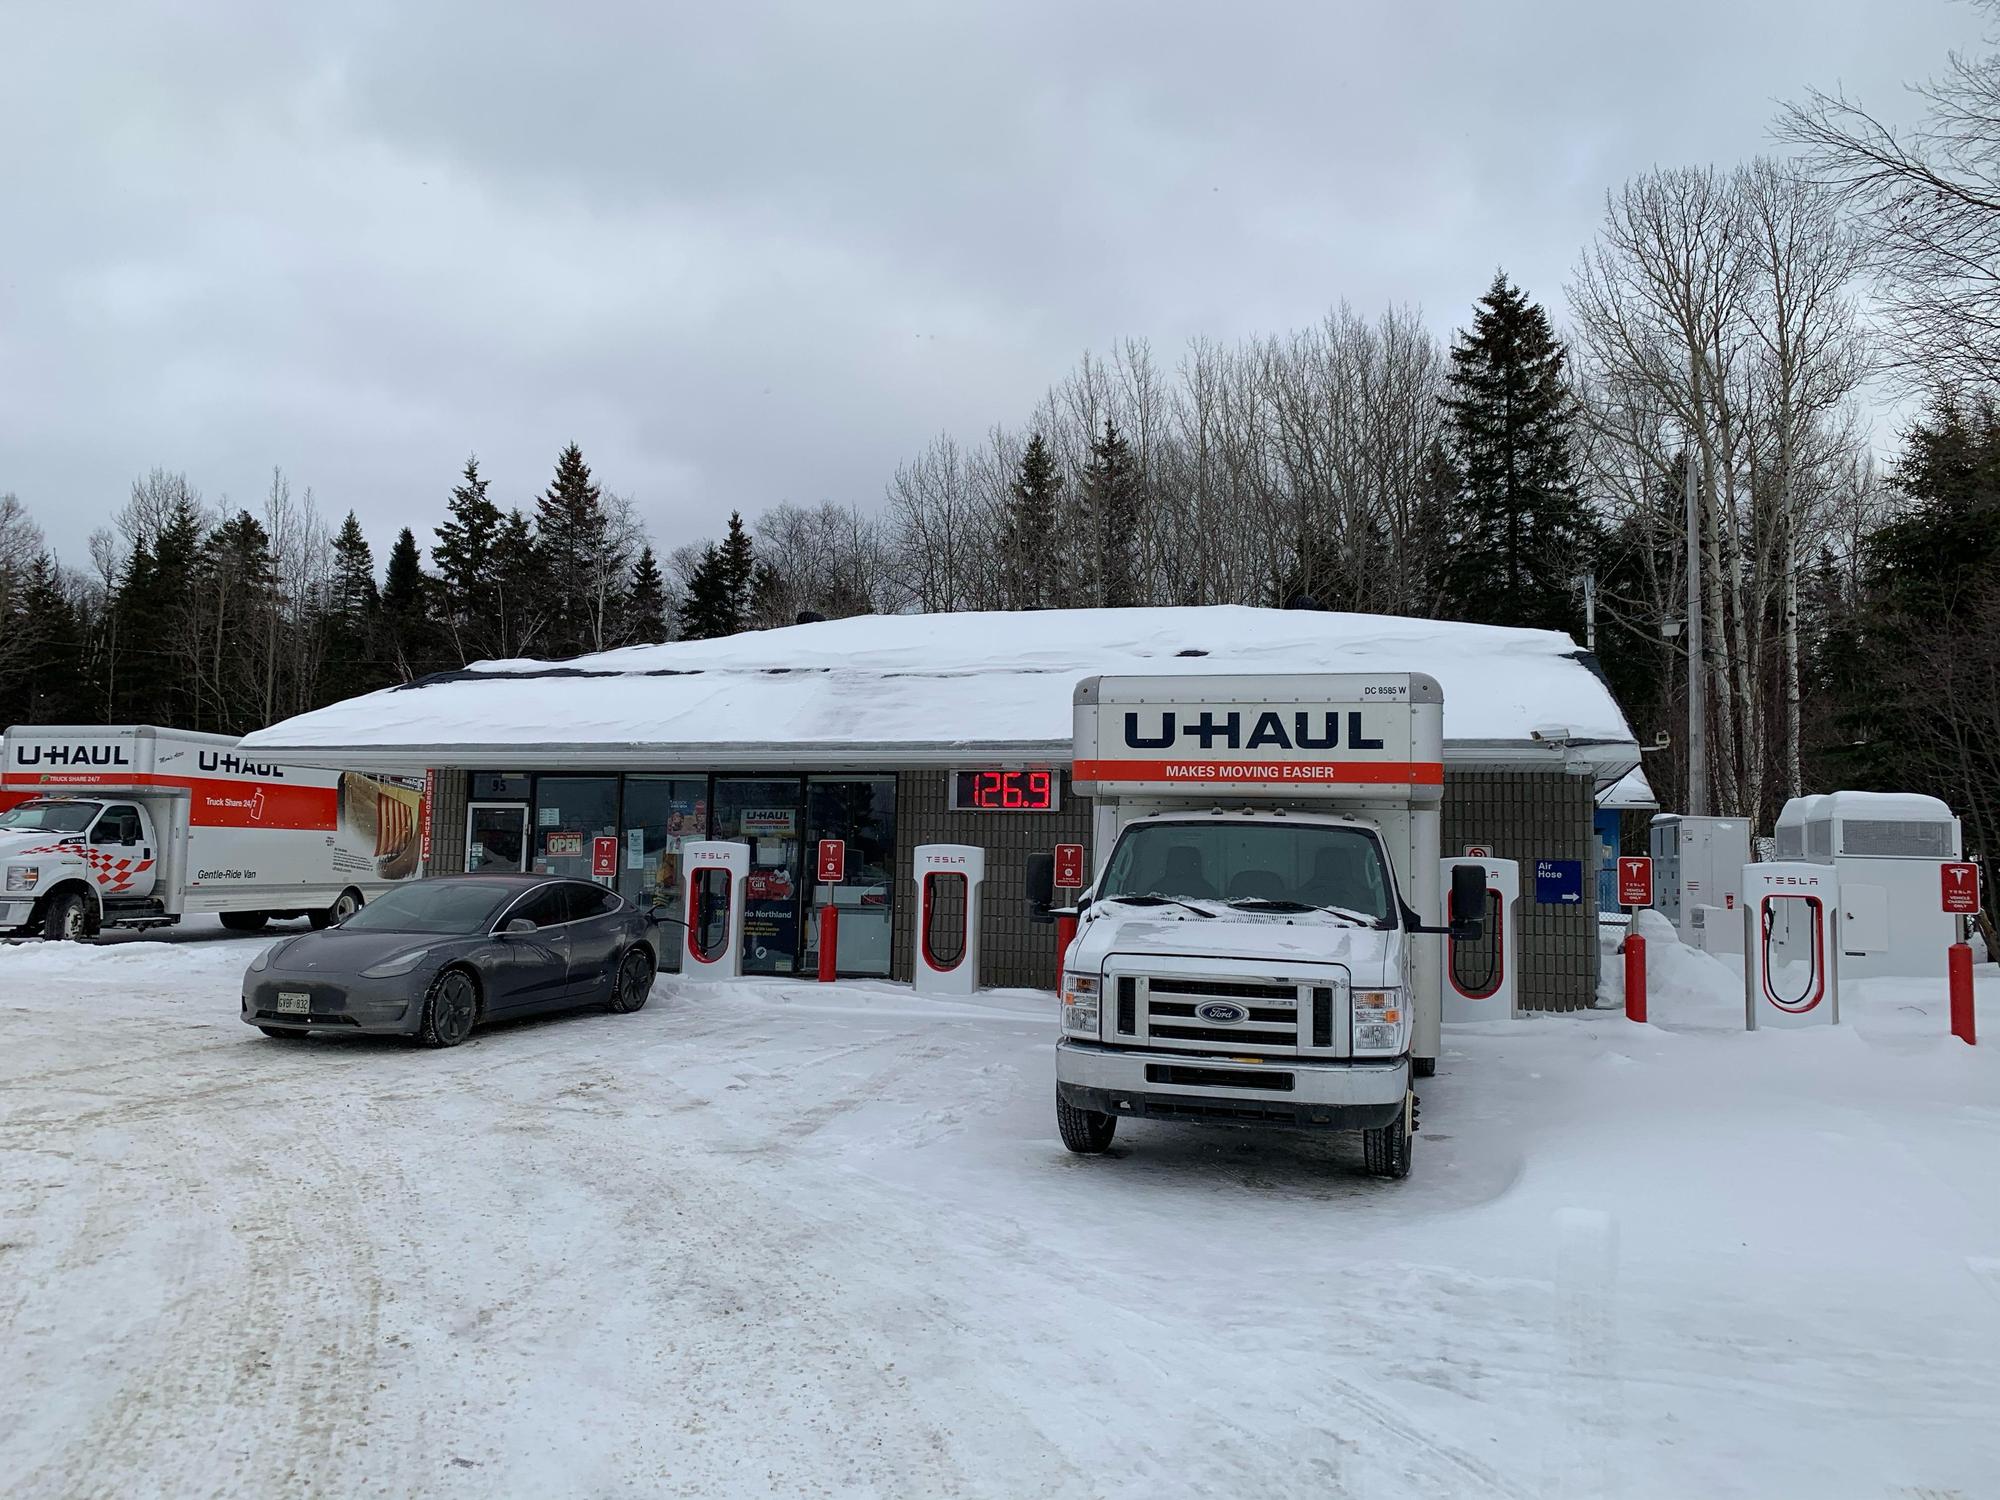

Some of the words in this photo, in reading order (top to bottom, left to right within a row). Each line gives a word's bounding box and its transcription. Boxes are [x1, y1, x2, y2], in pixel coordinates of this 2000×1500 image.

[1364, 686, 1377, 695] DC
[1378, 686, 1397, 695] 8585
[1398, 686, 1407, 694] W
[1124, 711, 1384, 750] U-HAUL
[17, 745, 129, 765] U-HAUL
[198, 750, 284, 778] U-HAUL
[1165, 765, 1216, 778] MAKES
[1219, 765, 1279, 778] MOVING
[1283, 766, 1335, 779] EASIER
[87, 775, 101, 783] 24/7
[973, 772, 1049, 808] 126.9
[205, 796, 224, 807] Truck
[224, 798, 243, 807] Share
[243, 799, 257, 809] 24/7
[746, 811, 790, 820] U-HAUL
[548, 838, 581, 853] OPEN
[693, 852, 730, 860] TESLA
[926, 856, 966, 864] TESLA
[1538, 862, 1553, 870] Air
[197, 869, 242, 879] Gentle-Ride
[243, 869, 257, 879] Van
[1537, 870, 1562, 879] Hose
[752, 880, 766, 888] Gift
[1763, 876, 1819, 886] TESLA
[755, 910, 792, 919] Northland
[1209, 1007, 1233, 1019] Ford
